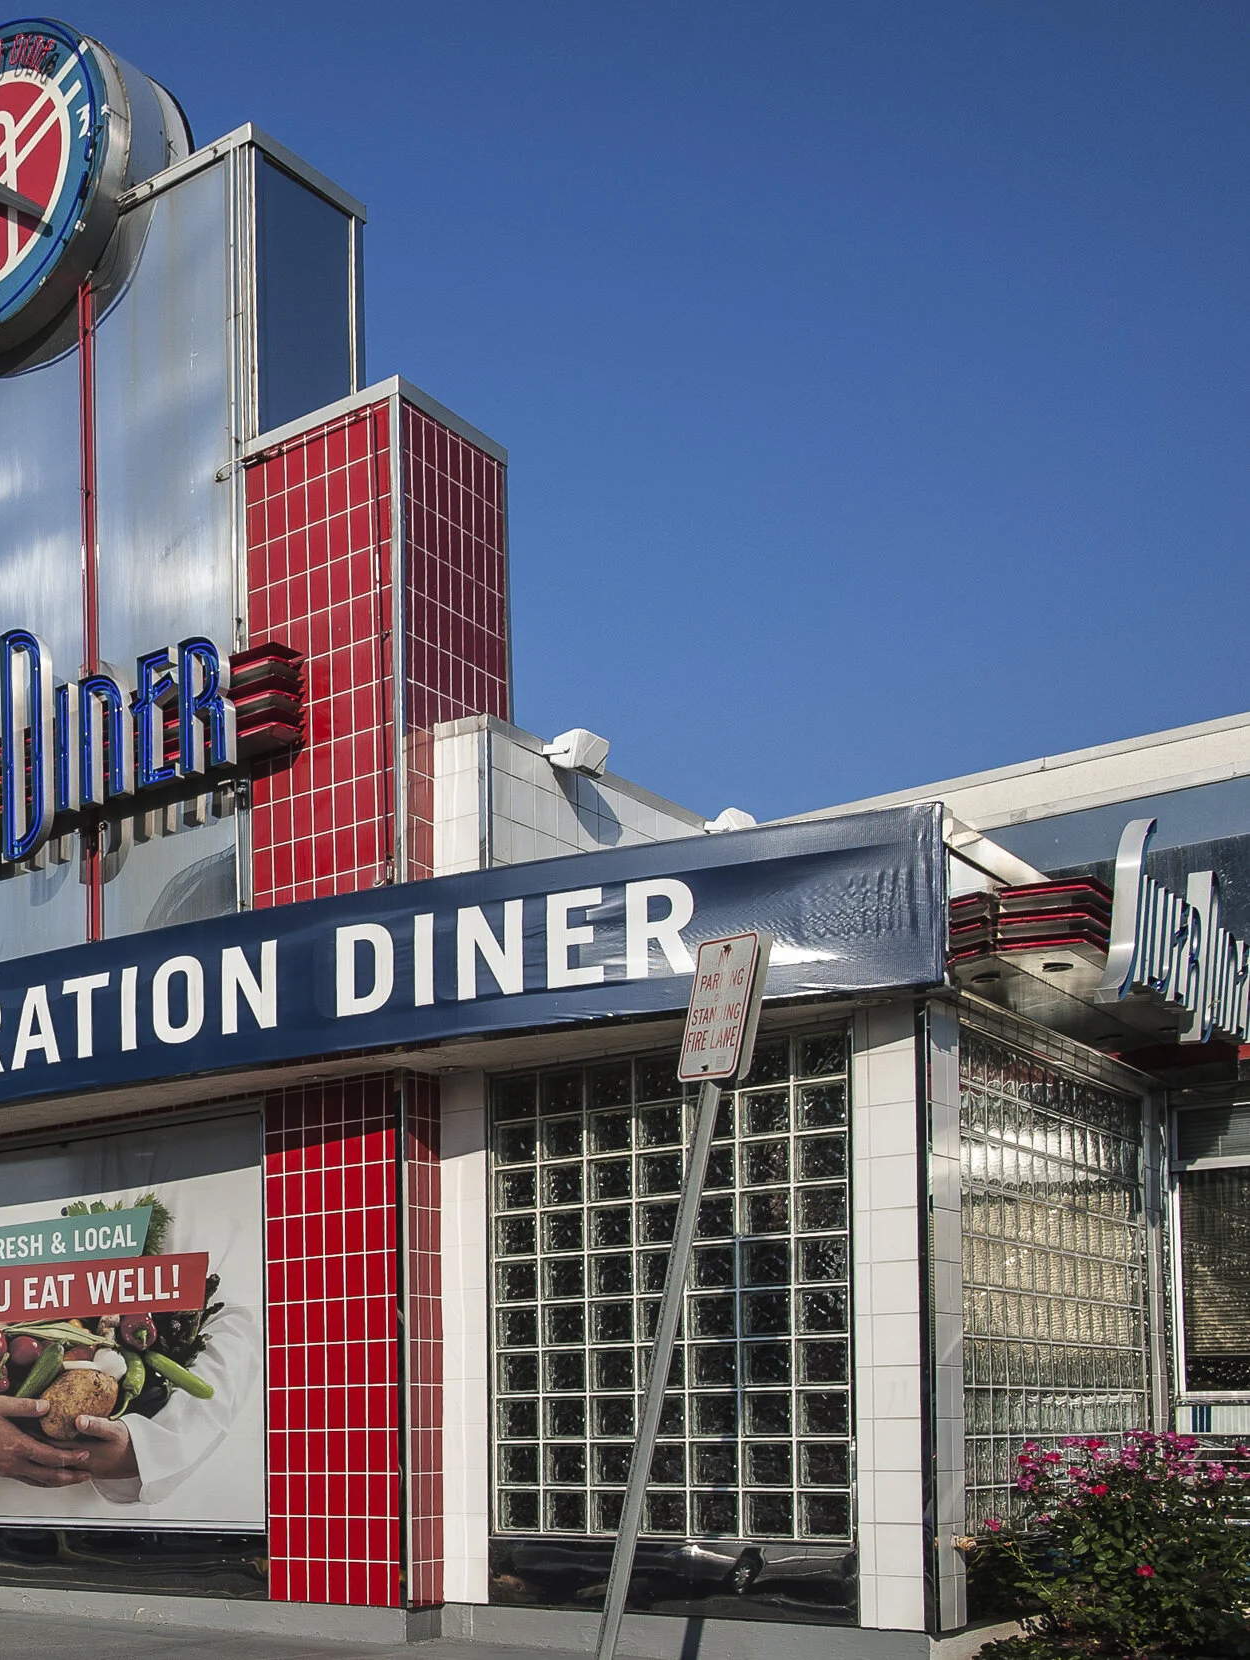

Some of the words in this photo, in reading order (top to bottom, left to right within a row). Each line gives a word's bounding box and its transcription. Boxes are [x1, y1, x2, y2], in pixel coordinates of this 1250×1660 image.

[0, 628, 238, 863] DINER
[336, 878, 697, 1018] DINER
[700, 968, 744, 992] PARNG
[686, 1030, 708, 1052] FIRE
[710, 1025, 737, 1049] LANE
[51, 1231, 66, 1255] &
[74, 1224, 137, 1252] LOCAL
[23, 1270, 75, 1310] EAT
[86, 1264, 180, 1307] WELL!
